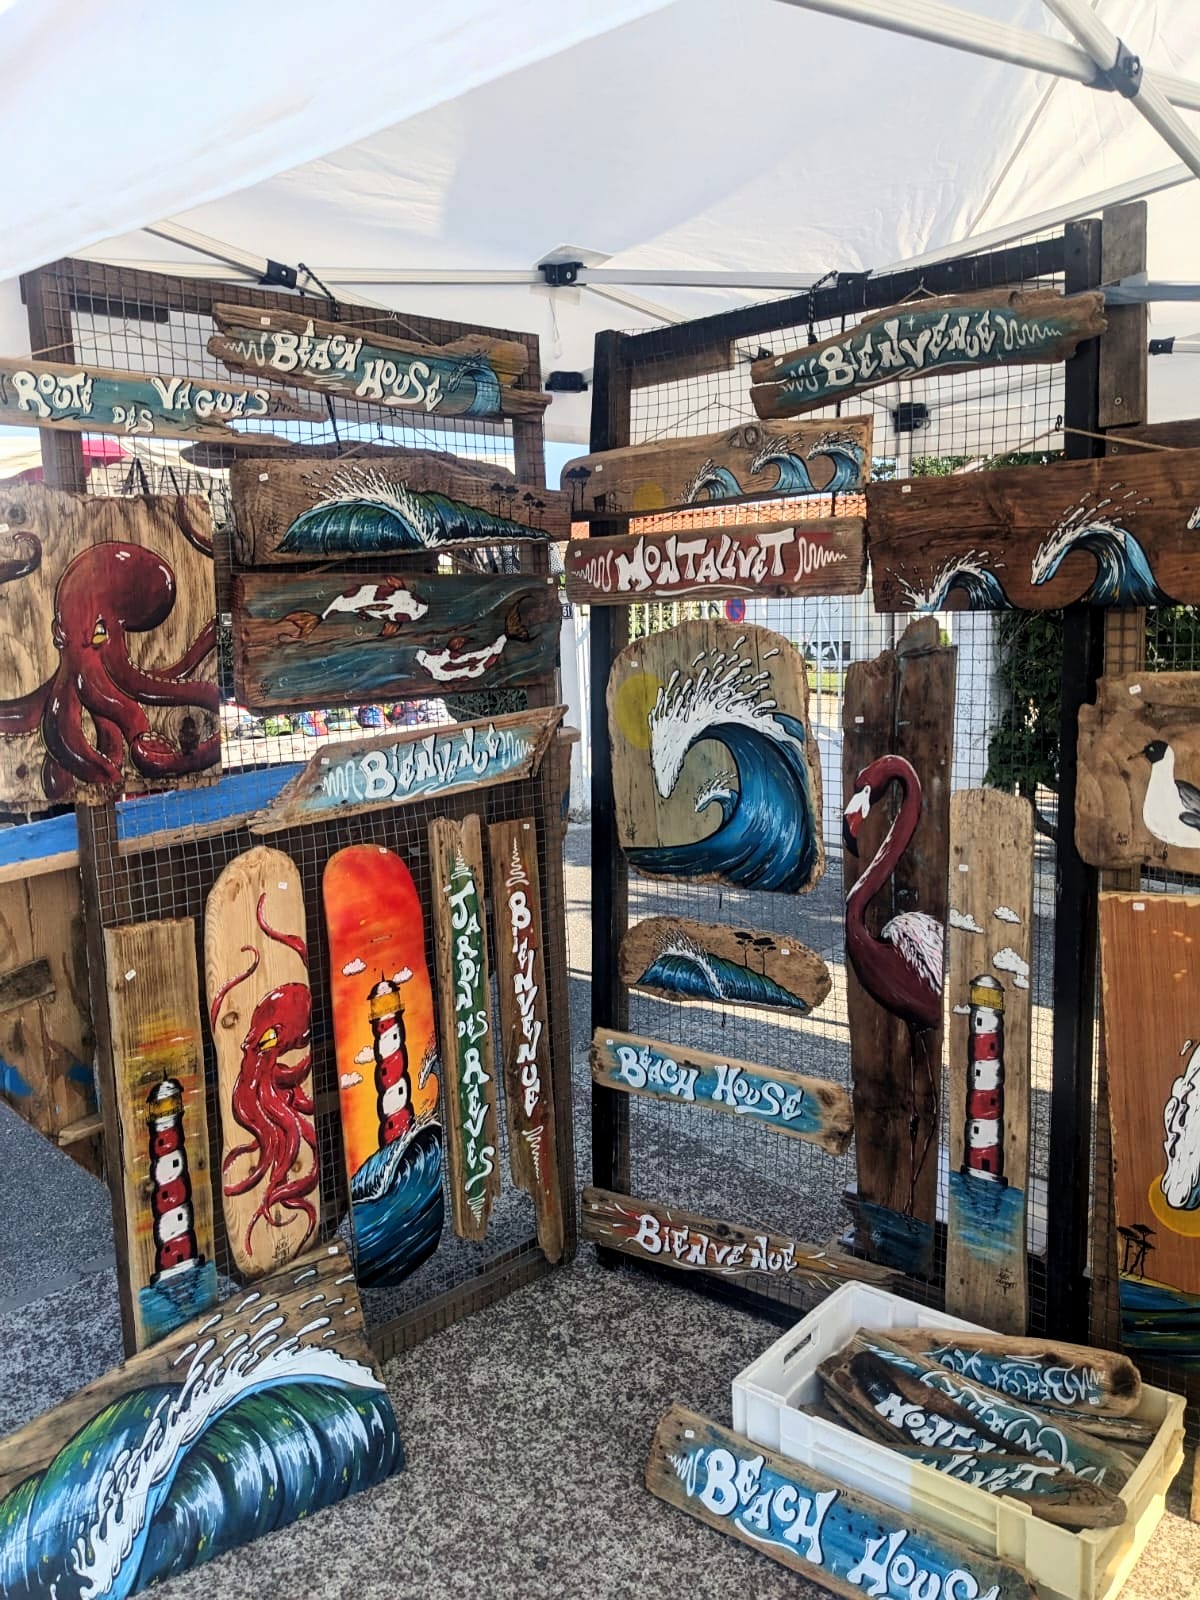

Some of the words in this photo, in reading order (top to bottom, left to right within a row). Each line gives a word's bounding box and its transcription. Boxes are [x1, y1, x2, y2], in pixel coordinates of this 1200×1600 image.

[12, 370, 97, 418] ROUTE
[112, 405, 155, 434] DES
[151, 376, 272, 418] VAGUES
[271, 319, 364, 372] BEACH
[355, 358, 444, 412] HOUSE
[457, 1010, 489, 1044] DES
[616, 1045, 700, 1101] BEACH
[711, 1063, 804, 1121] HOUSE
[700, 1448, 839, 1565] BEACH
